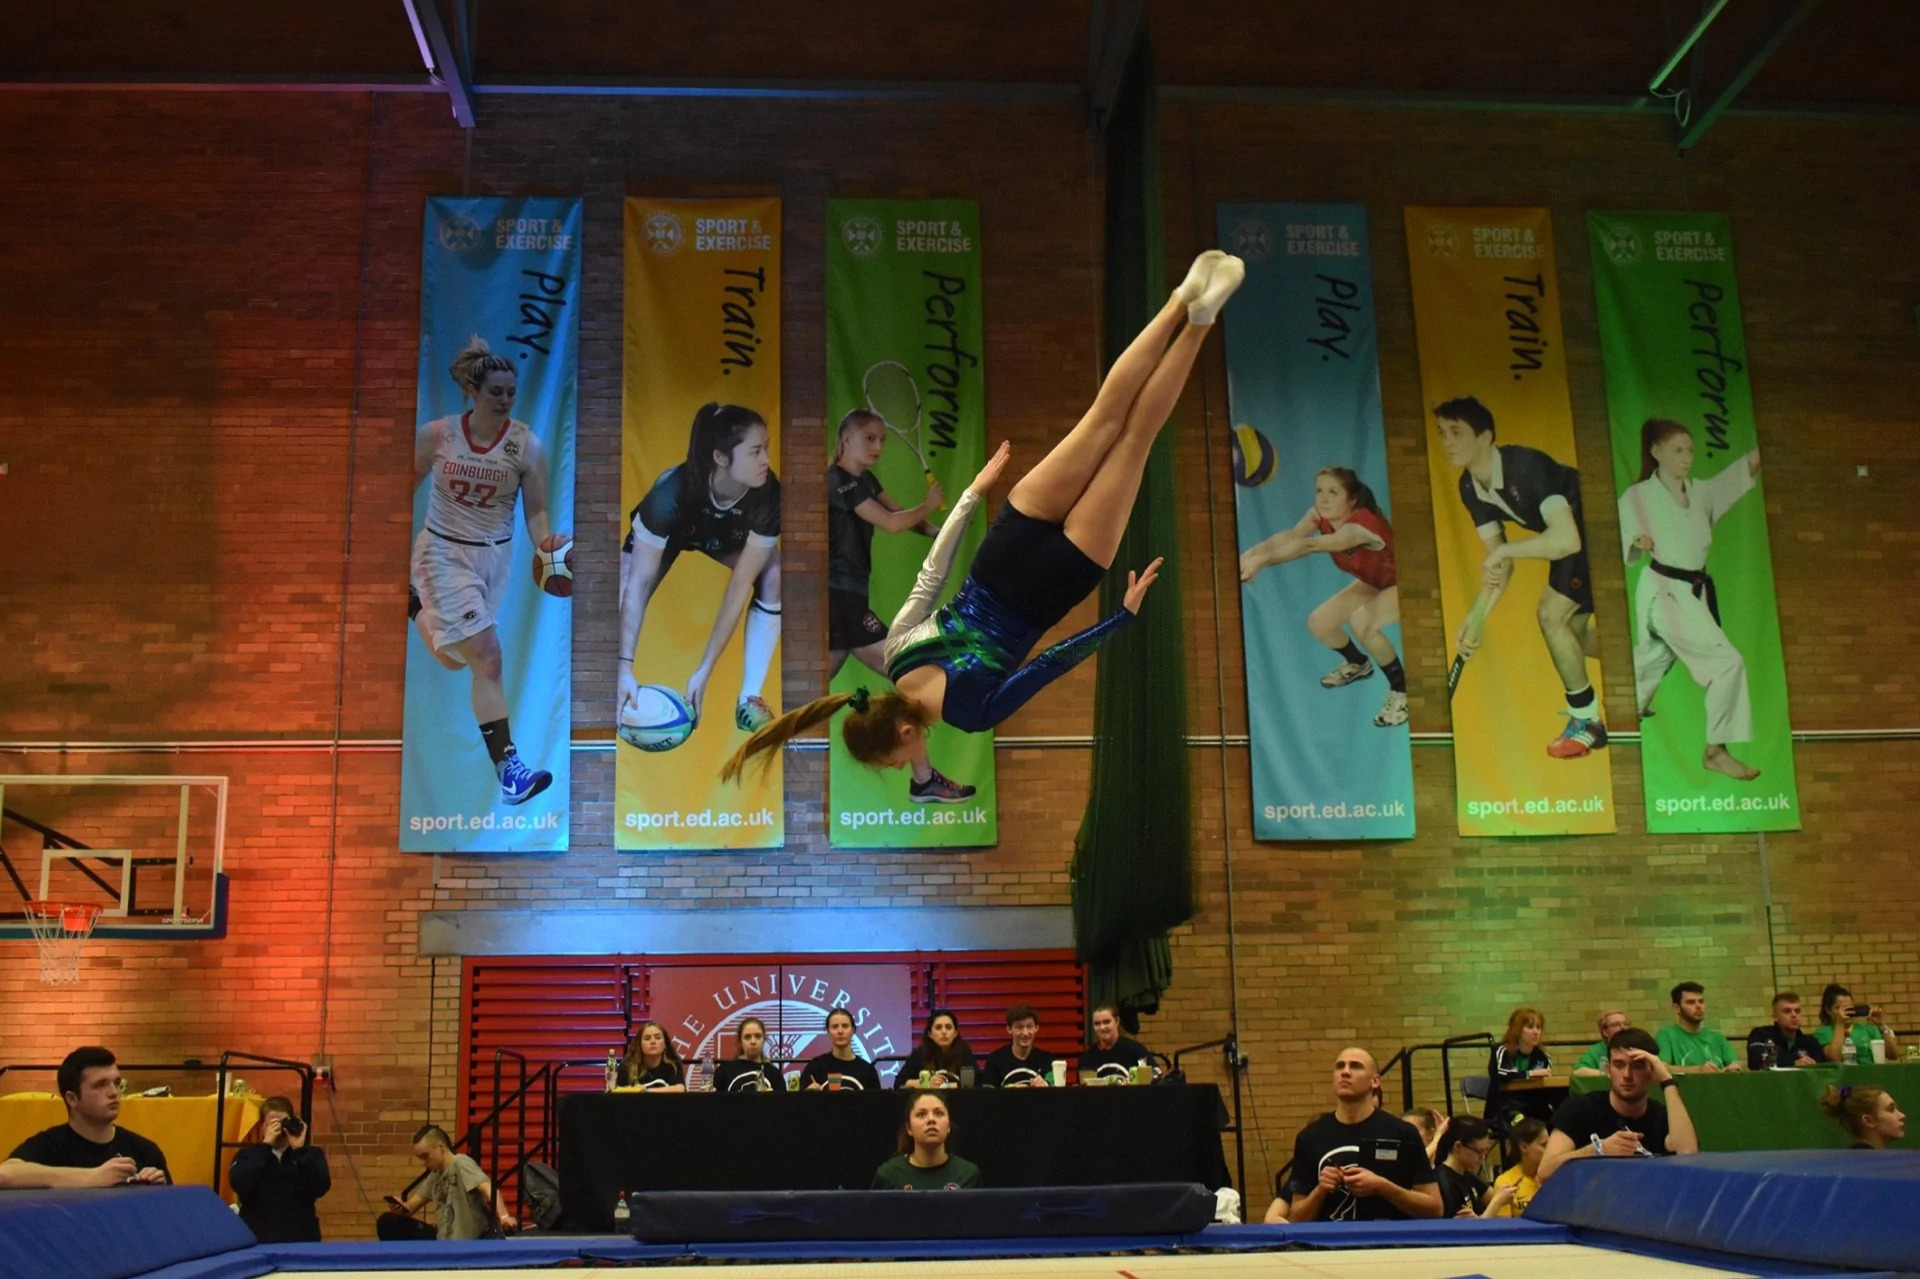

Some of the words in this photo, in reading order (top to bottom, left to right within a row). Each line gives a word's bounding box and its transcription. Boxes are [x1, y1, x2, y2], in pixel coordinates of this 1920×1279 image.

[497, 218, 549, 234] SPORT
[552, 218, 563, 234] &
[695, 218, 748, 235] SPORT
[751, 219, 762, 235] &
[896, 220, 948, 236] SPORT
[951, 220, 962, 237] &
[1286, 224, 1335, 240] SPORT
[1339, 224, 1349, 241] &
[1473, 228, 1521, 243] SPORT
[1524, 228, 1535, 244] &
[496, 234, 573, 250] EXERCISE
[695, 235, 772, 251] EXERCISE
[896, 236, 972, 252] EXERCISE
[1287, 240, 1360, 256] EXERCISE
[1654, 231, 1701, 246] SPORT
[1704, 231, 1715, 246] &
[1473, 244, 1545, 259] EXERCISE
[1656, 246, 1726, 261] EXERCISE
[507, 268, 567, 360] Play.
[722, 266, 766, 376] Train.
[1307, 273, 1361, 362] Play.
[1503, 274, 1549, 380] Train.
[923, 268, 978, 457] Perform.
[1683, 279, 1742, 459] Perform.
[443, 461, 508, 482] EDINBURGH
[1263, 800, 1406, 823] sport.ed.ac.uk
[1466, 796, 1606, 818] sport.ed.ac.uk
[1654, 793, 1792, 814] sport.ed.ac.uk
[408, 811, 559, 835] sport.ed.ac.uk
[624, 808, 775, 829] sport.ed.ac.uk
[839, 806, 988, 827] sport.ed.ac.uk
[711, 973, 901, 1077] UNIVERSITY
